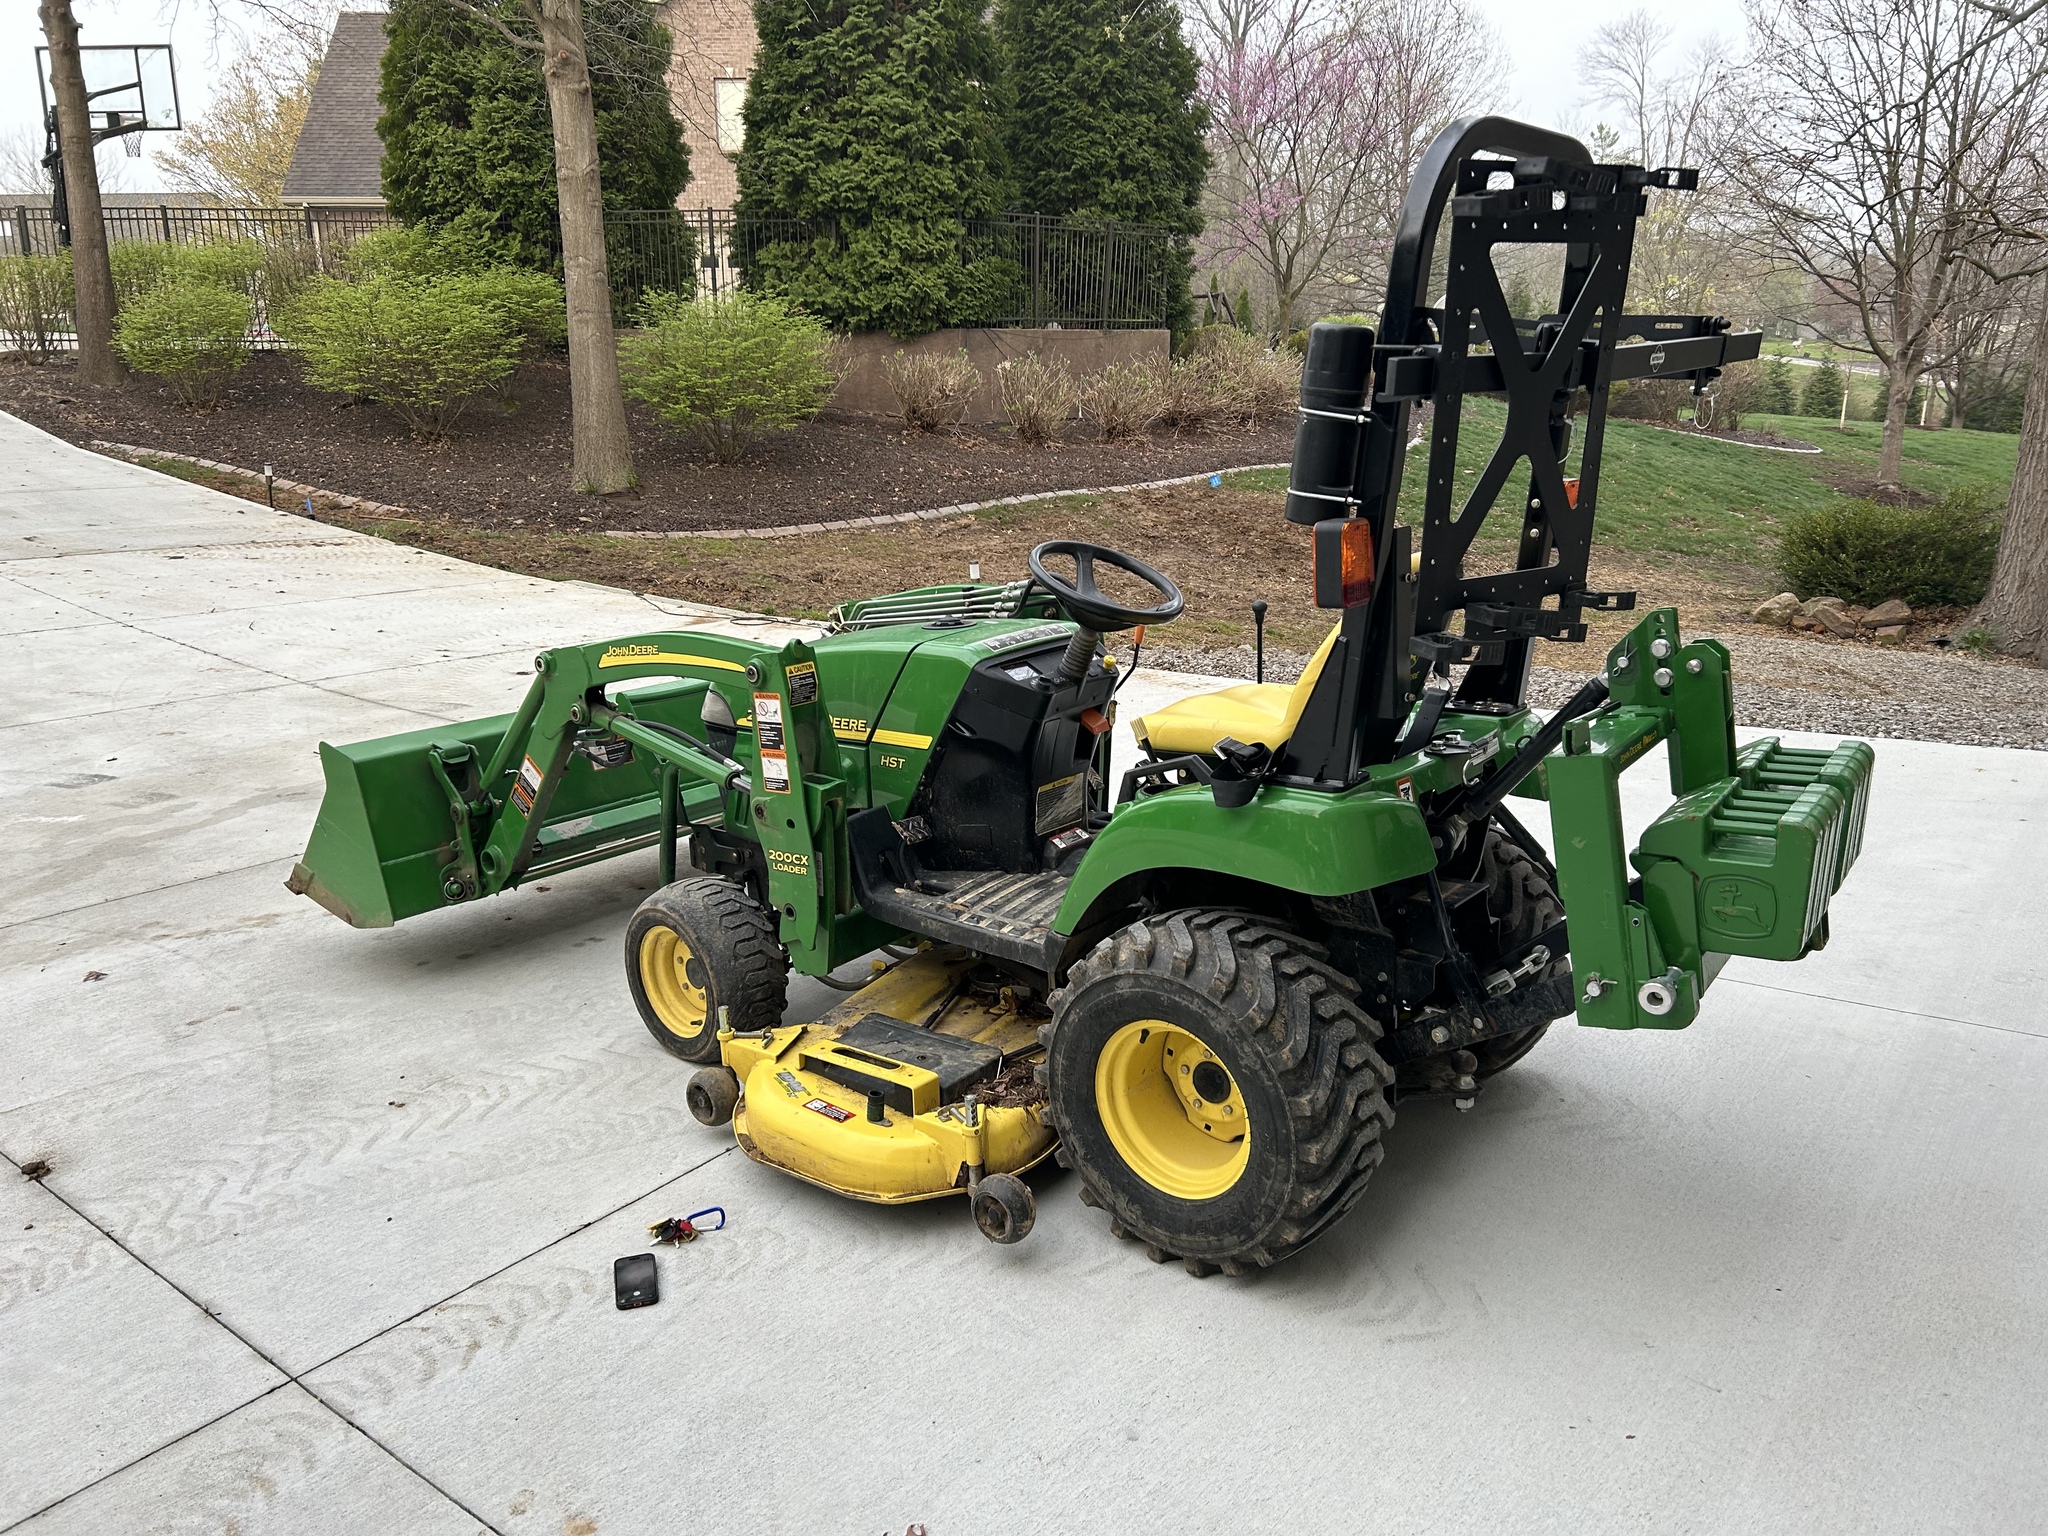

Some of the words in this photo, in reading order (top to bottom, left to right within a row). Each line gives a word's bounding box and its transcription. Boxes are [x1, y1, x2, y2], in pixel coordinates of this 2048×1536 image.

[606, 645, 629, 656] JOHN
[629, 644, 659, 655] DEERE
[793, 663, 813, 673] CAUTION
[829, 714, 867, 731] EERE
[880, 755, 906, 769] HST
[768, 849, 809, 866] 200CX
[772, 862, 808, 876] LOADER
